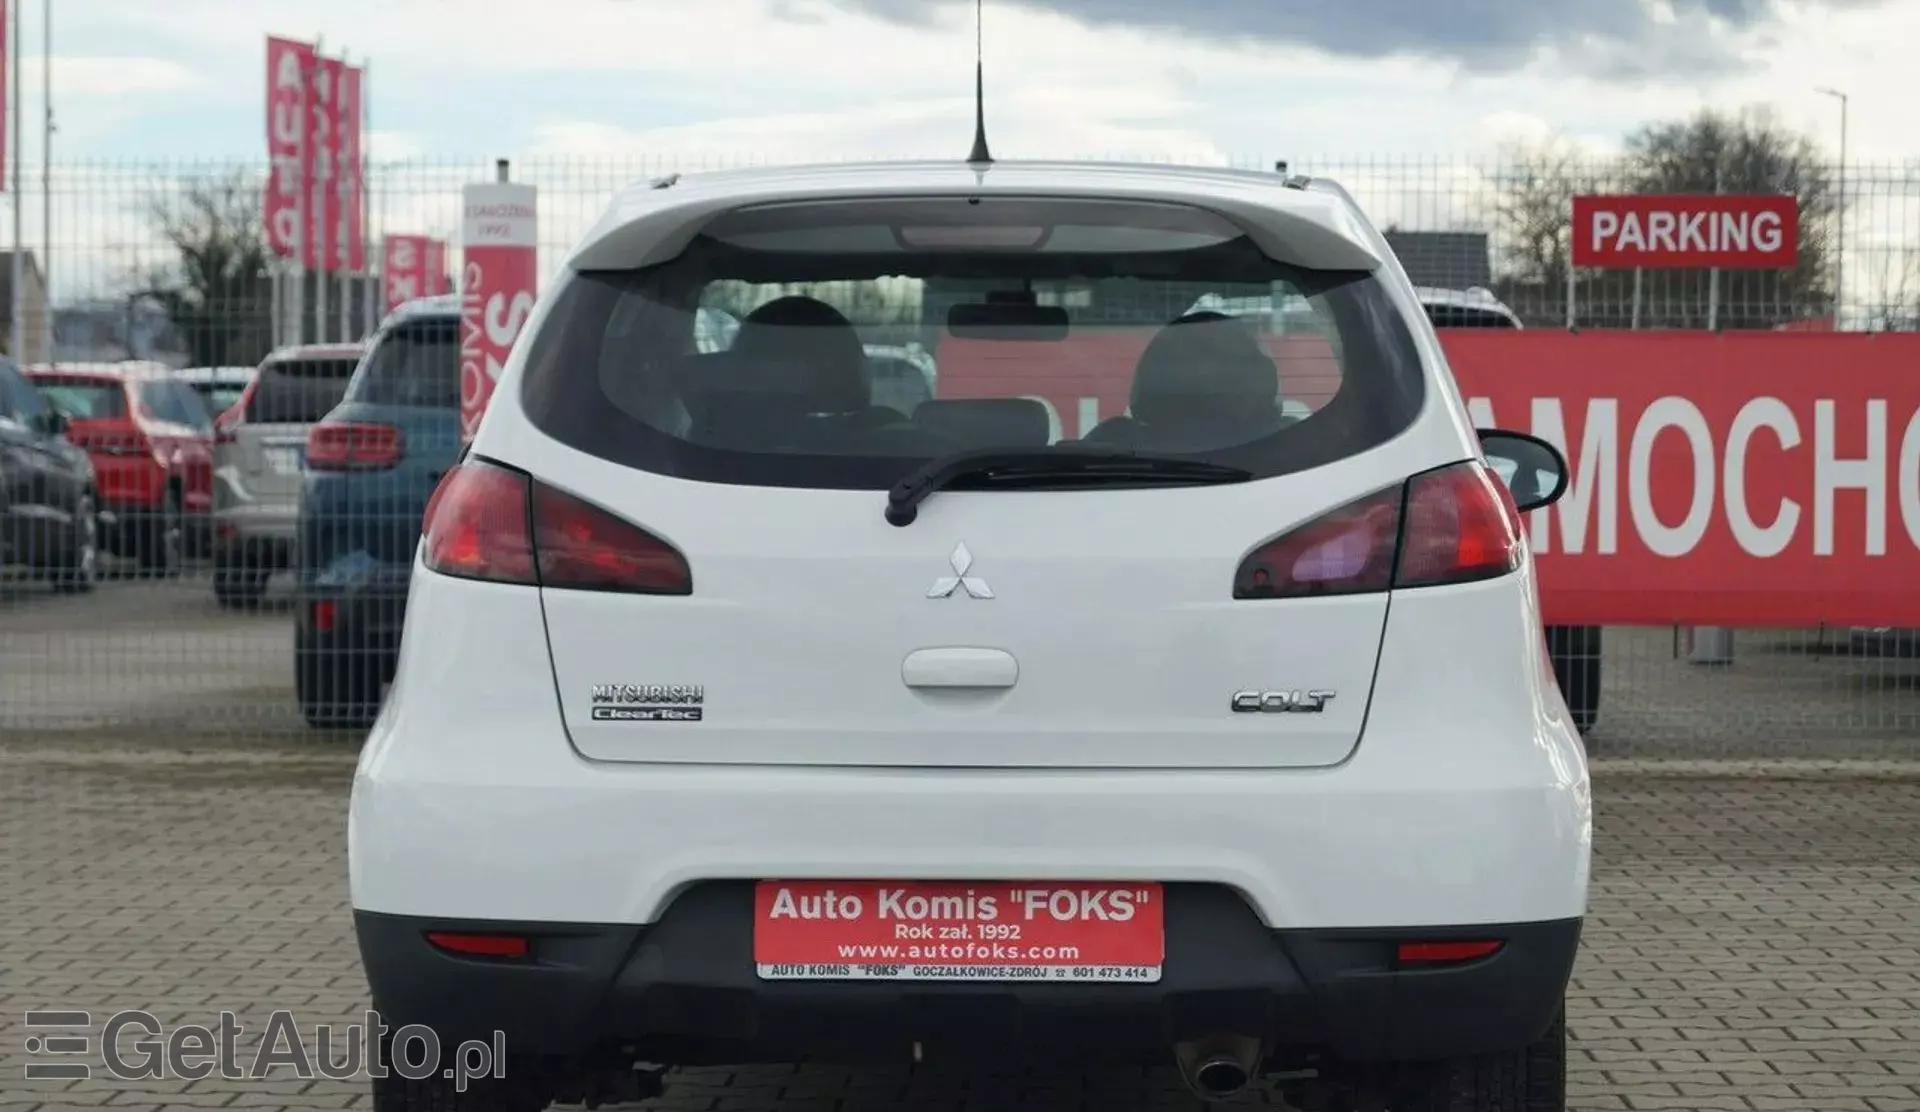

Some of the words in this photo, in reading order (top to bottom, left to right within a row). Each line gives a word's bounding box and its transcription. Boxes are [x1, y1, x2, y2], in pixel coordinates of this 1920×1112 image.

[1591, 211, 1783, 252] PARKING
[461, 261, 484, 442] KOMIS
[1467, 396, 1920, 557] MOCH
[592, 684, 704, 703] MITSUBISHI
[1232, 690, 1336, 712] COLT
[769, 888, 863, 920] Auto
[879, 889, 998, 920] Komis
[1011, 889, 1149, 921] "FOKS"
[895, 924, 933, 939] Rok
[939, 924, 972, 940] zał.
[977, 925, 1021, 939] 1992
[838, 943, 1079, 959] www.autofoks.com
[771, 964, 805, 975] AUTO
[809, 964, 850, 975] KOMIS
[913, 965, 1047, 978] GOCZAŁKOWICE-ZDRÓJ
[1073, 967, 1094, 978] 601
[1099, 967, 1121, 978] 473
[1125, 967, 1147, 978] 414
